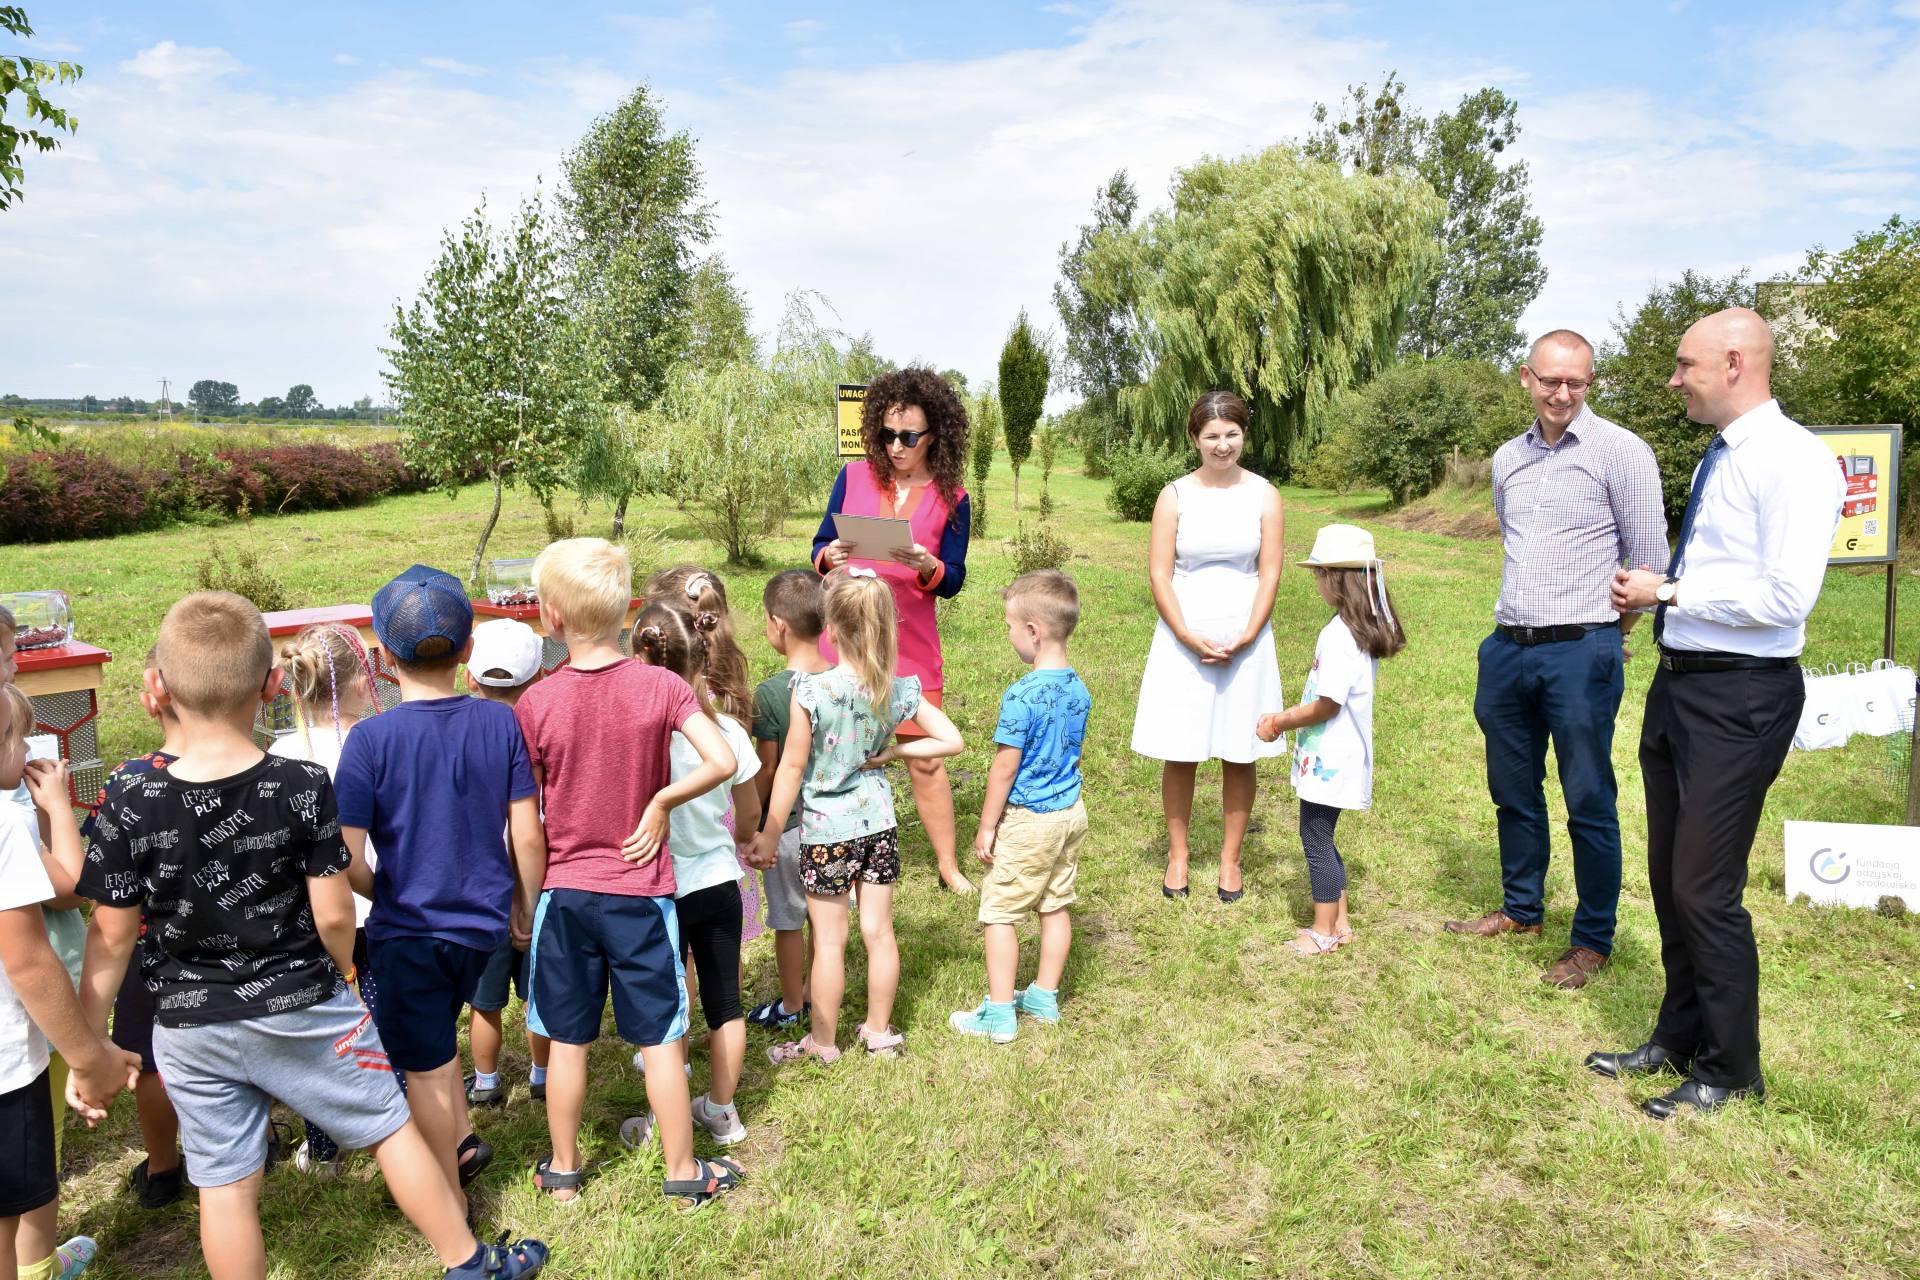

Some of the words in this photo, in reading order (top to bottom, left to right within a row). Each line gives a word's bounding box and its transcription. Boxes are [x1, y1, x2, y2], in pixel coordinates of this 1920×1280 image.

[142, 781, 168, 790] FUNNY
[257, 781, 281, 790] FUNNY
[195, 797, 222, 817] PLAY
[199, 809, 254, 849] MONSTER
[233, 826, 290, 854] FANTASTIC
[159, 862, 184, 871] FUNNY
[1856, 868, 1902, 880] odzyskaj
[206, 872, 230, 893] PLAY
[112, 884, 139, 900] PLAY
[216, 873, 269, 911] MONSTER
[164, 923, 187, 936] FUNNY
